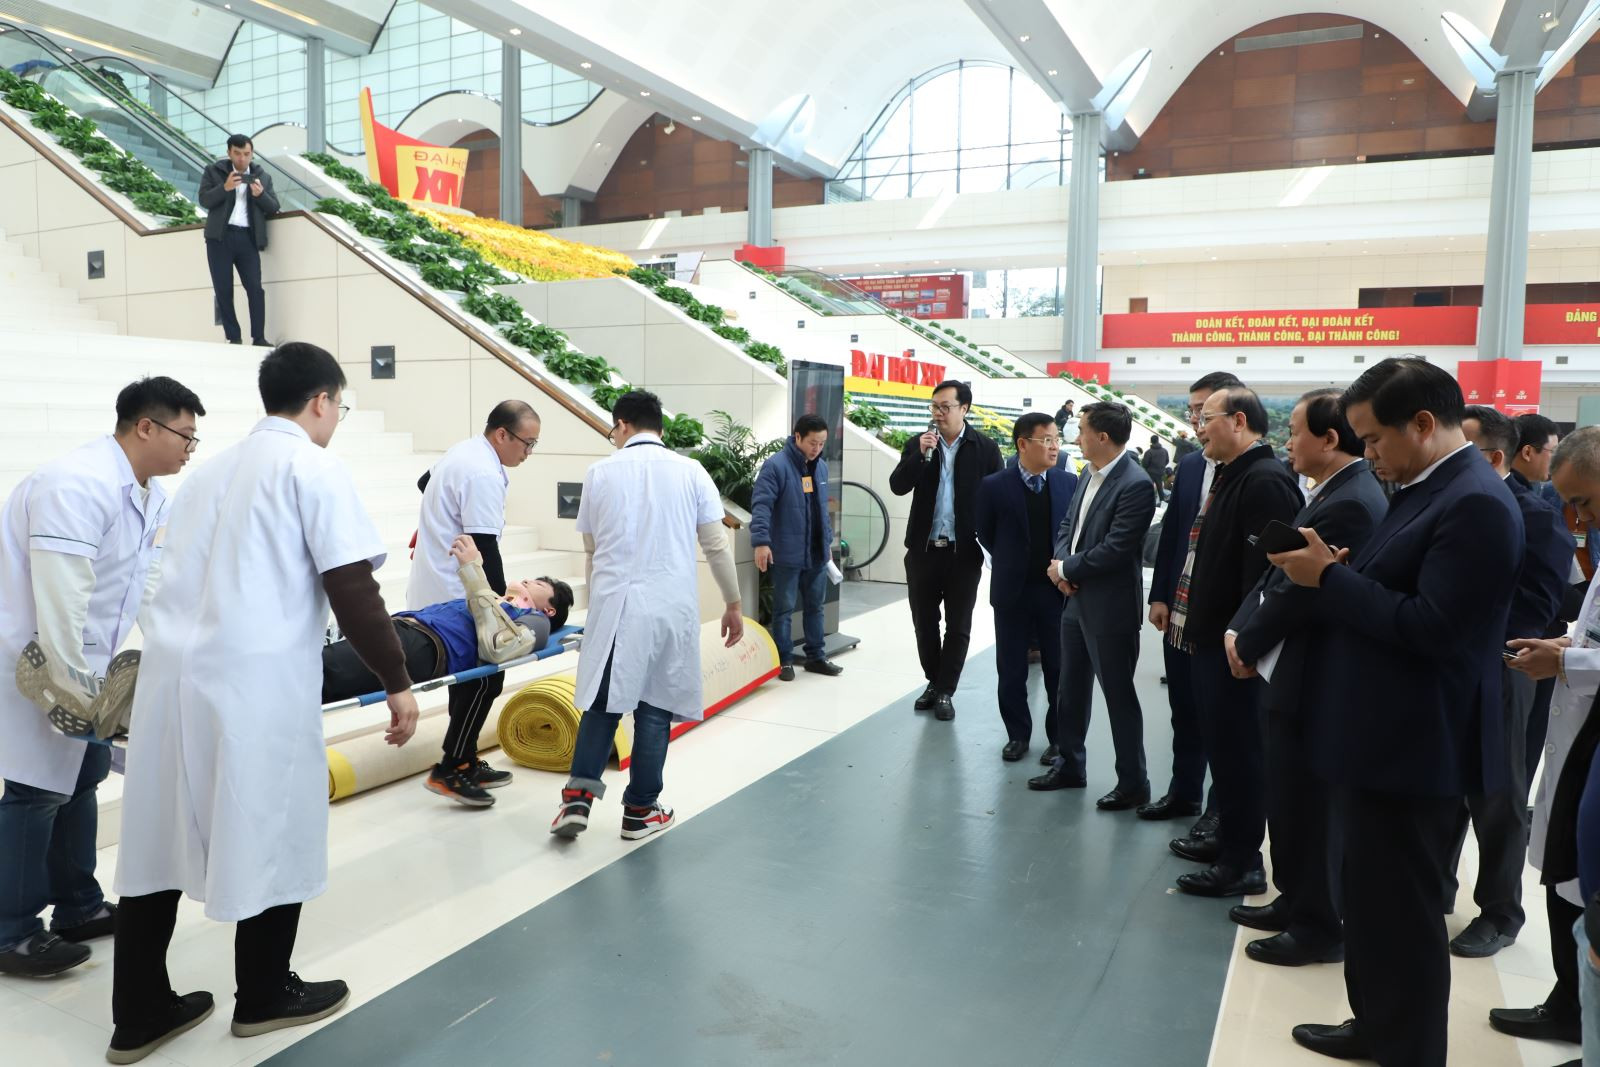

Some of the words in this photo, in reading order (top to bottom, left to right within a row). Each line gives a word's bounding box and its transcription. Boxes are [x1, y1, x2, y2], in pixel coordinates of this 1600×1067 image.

[413, 151, 449, 165] ĐẠI
[1195, 317, 1222, 329] ĐOÀN
[1225, 316, 1245, 329] KẾT,
[1247, 316, 1275, 328] ĐOÀN
[1278, 314, 1299, 328] KẾT,
[1301, 316, 1320, 328] ĐẠI
[1322, 314, 1351, 327] ĐOÀN
[1354, 312, 1374, 326] KẾT
[1565, 308, 1598, 322] ĐẢNG
[1172, 331, 1203, 342] THÀNH
[1205, 330, 1235, 343] CÔNG,
[1238, 330, 1271, 342] THÀNH
[1273, 329, 1305, 342] CÔNG,
[1307, 330, 1326, 343] ĐẠI
[1328, 329, 1363, 341] THÀNH
[1366, 328, 1400, 341] CÔNG!
